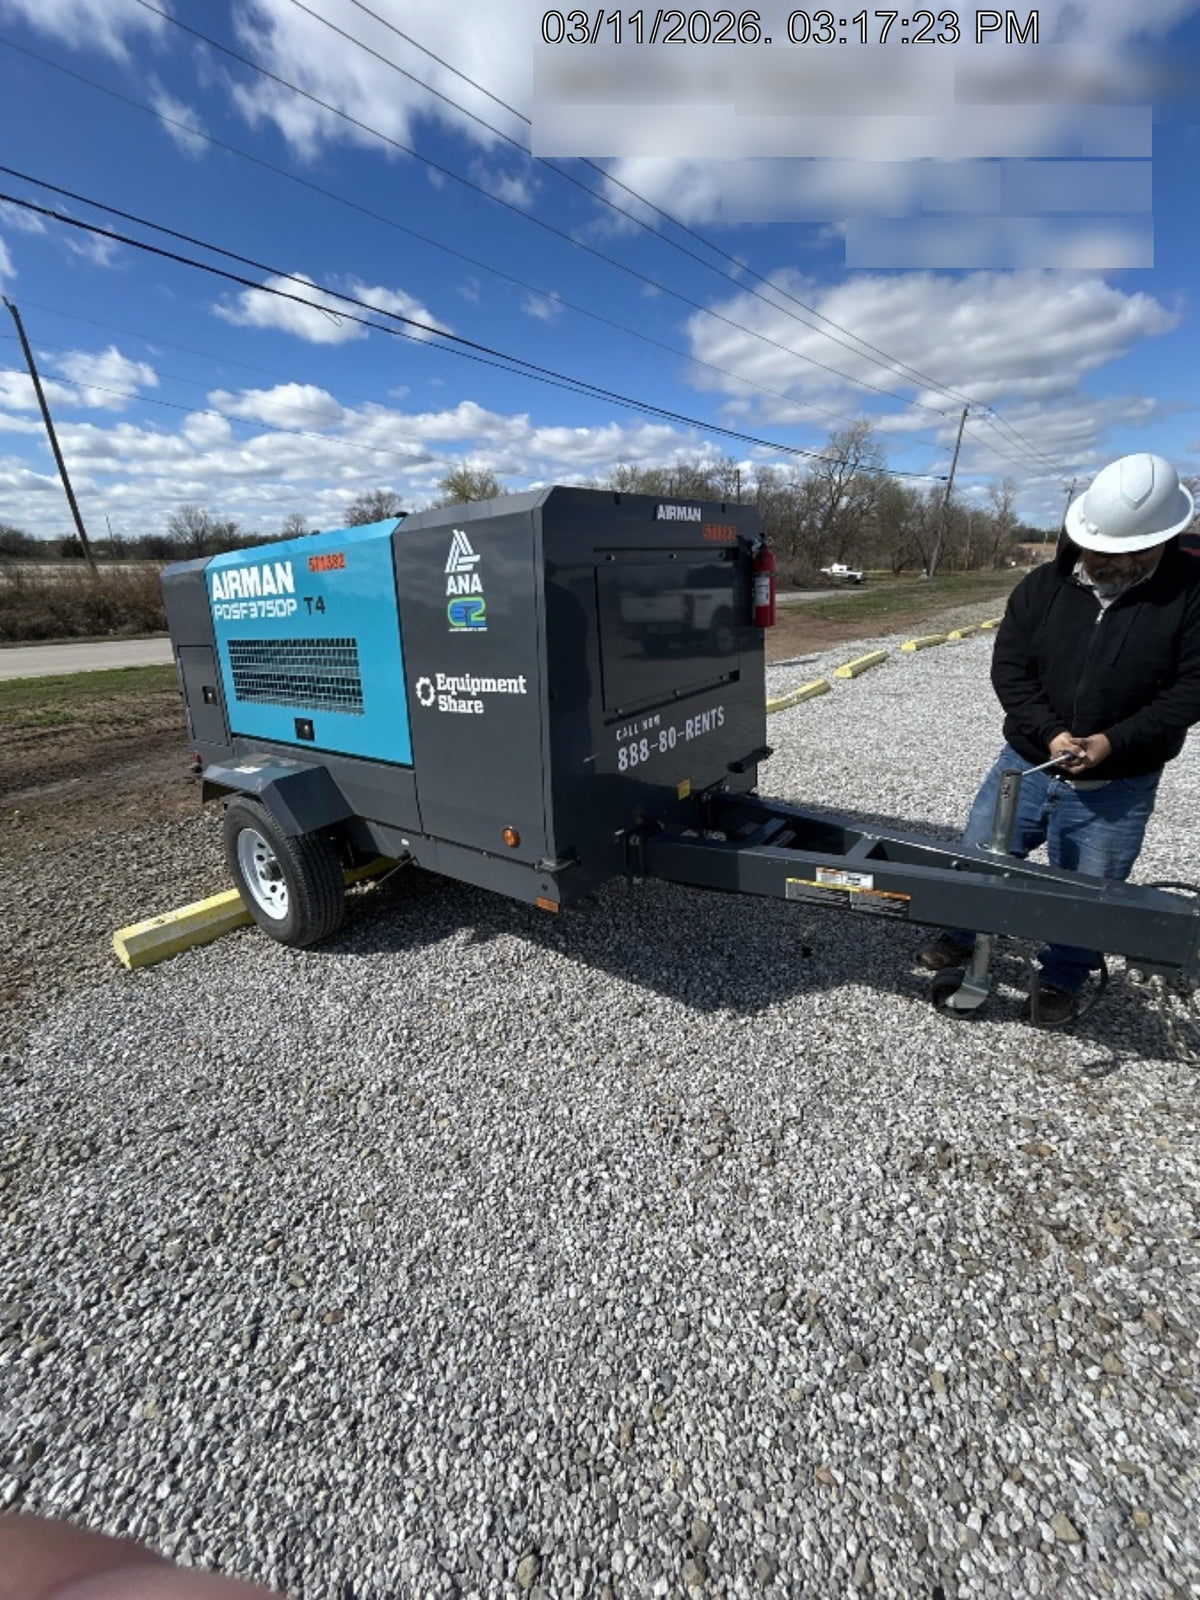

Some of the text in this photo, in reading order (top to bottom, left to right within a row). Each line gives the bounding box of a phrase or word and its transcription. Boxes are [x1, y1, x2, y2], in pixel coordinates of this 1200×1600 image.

[657, 504, 702, 521] AIRMAN
[212, 561, 295, 601] AIRMAN
[446, 573, 484, 596] ANA
[303, 595, 326, 615] T4
[435, 672, 528, 696] Equipment
[438, 694, 485, 714] Share
[616, 722, 640, 742] CALL
